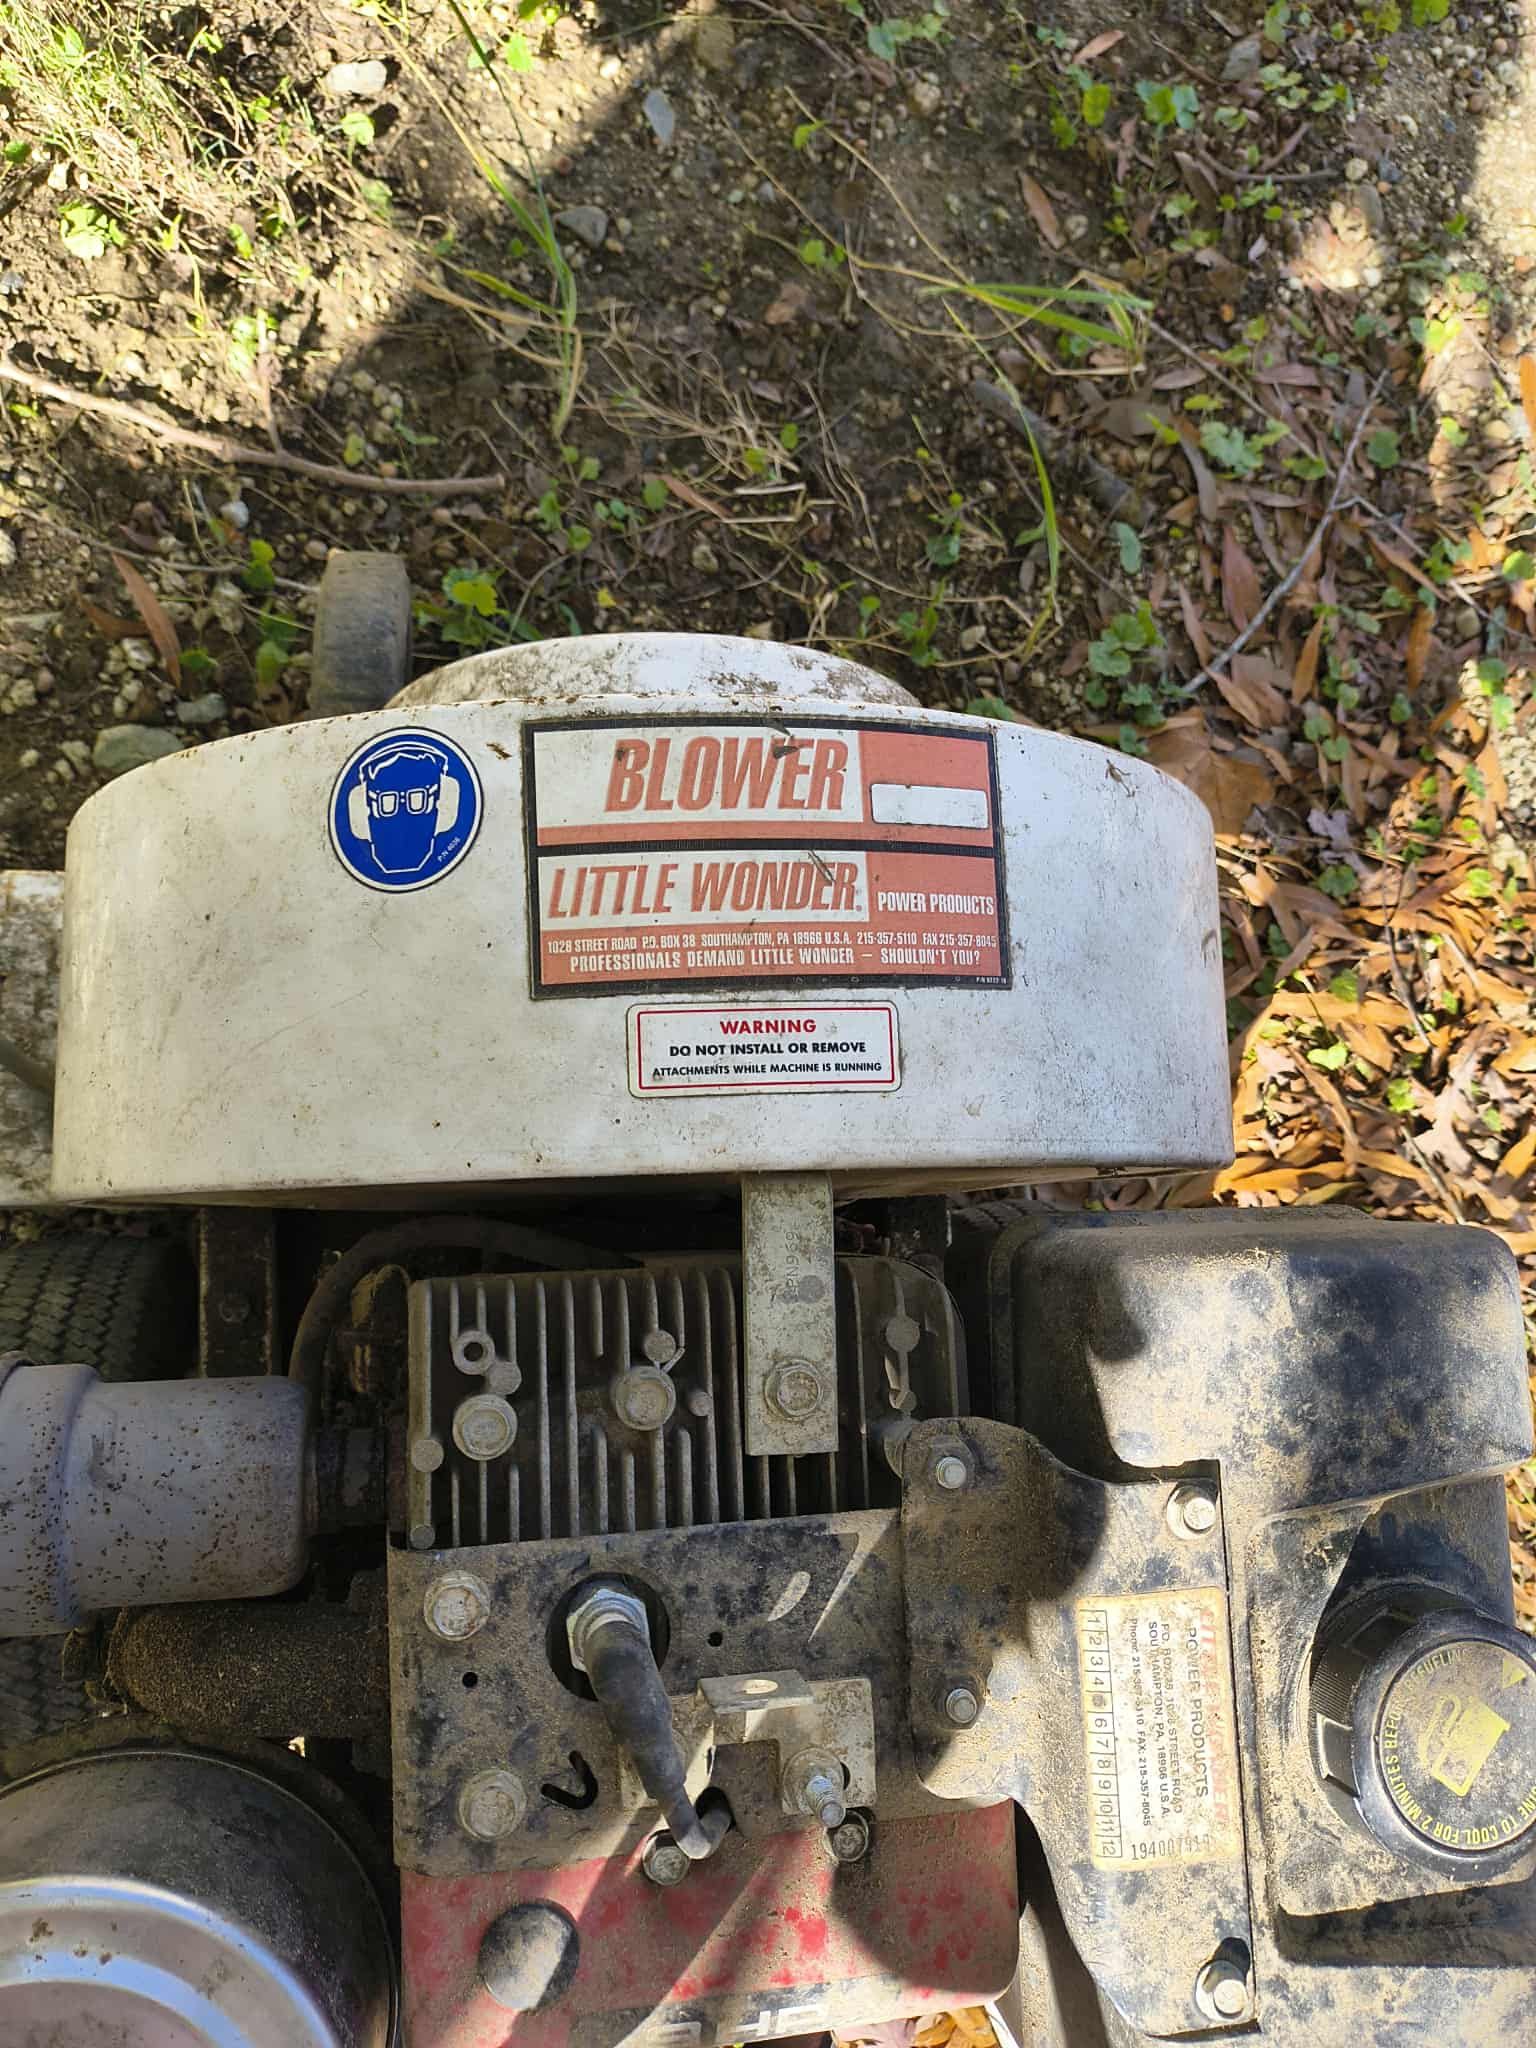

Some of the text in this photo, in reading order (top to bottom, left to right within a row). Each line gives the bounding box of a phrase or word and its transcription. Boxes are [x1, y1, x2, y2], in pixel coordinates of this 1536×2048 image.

[604, 736, 848, 813] BLOWER
[548, 863, 678, 919] LITTLE
[878, 891, 995, 915] POWER PRODUCTS
[548, 940, 572, 953] 1028
[574, 937, 608, 952] STREET
[611, 937, 637, 950] ROAD
[660, 934, 680, 948] BOX
[682, 933, 696, 947] 38
[701, 931, 775, 947] SOUTHAMPTON,
[777, 932, 788, 945] PA
[824, 932, 852, 945] U.S.A.
[923, 933, 938, 946] FAX
[570, 952, 681, 972] PROFESSIONALS
[687, 949, 745, 968] DEMAND
[751, 948, 793, 966] LITTLE
[799, 948, 854, 965] WONDER
[881, 948, 946, 965] SHOULDN'T
[952, 949, 981, 965] YOU?
[719, 1019, 817, 1034] WARNING
[669, 1042, 866, 1056] DO NOT INSTALL OR REMOVE
[653, 1062, 882, 1077] ATTACHMENTS WHILE MACHINE IS RUNNING
[1089, 1636, 1102, 1646] 2
[1090, 1656, 1103, 1666] 3
[1092, 1677, 1105, 1686] 4
[1185, 1627, 1208, 1797] POWER PRODUCTS
[1095, 1718, 1107, 1728] 6
[1096, 1738, 1109, 1748] 7
[1136, 1731, 1146, 1754] FAX:
[1168, 1728, 1179, 1776] STREET
[1097, 1759, 1111, 1769] 8
[1098, 1780, 1111, 1790] 9
[1384, 1755, 1424, 1819] MINUTES
[1171, 1778, 1183, 1814] ROAD
[1100, 1799, 1113, 1814] 10
[1102, 1820, 1115, 1832] 11
[1420, 1815, 1433, 1831] 2
[1500, 1814, 1518, 1834] TO
[1433, 1821, 1461, 1845] FOR
[1465, 1827, 1500, 1845] COOL
[1102, 1840, 1116, 1856] 12
